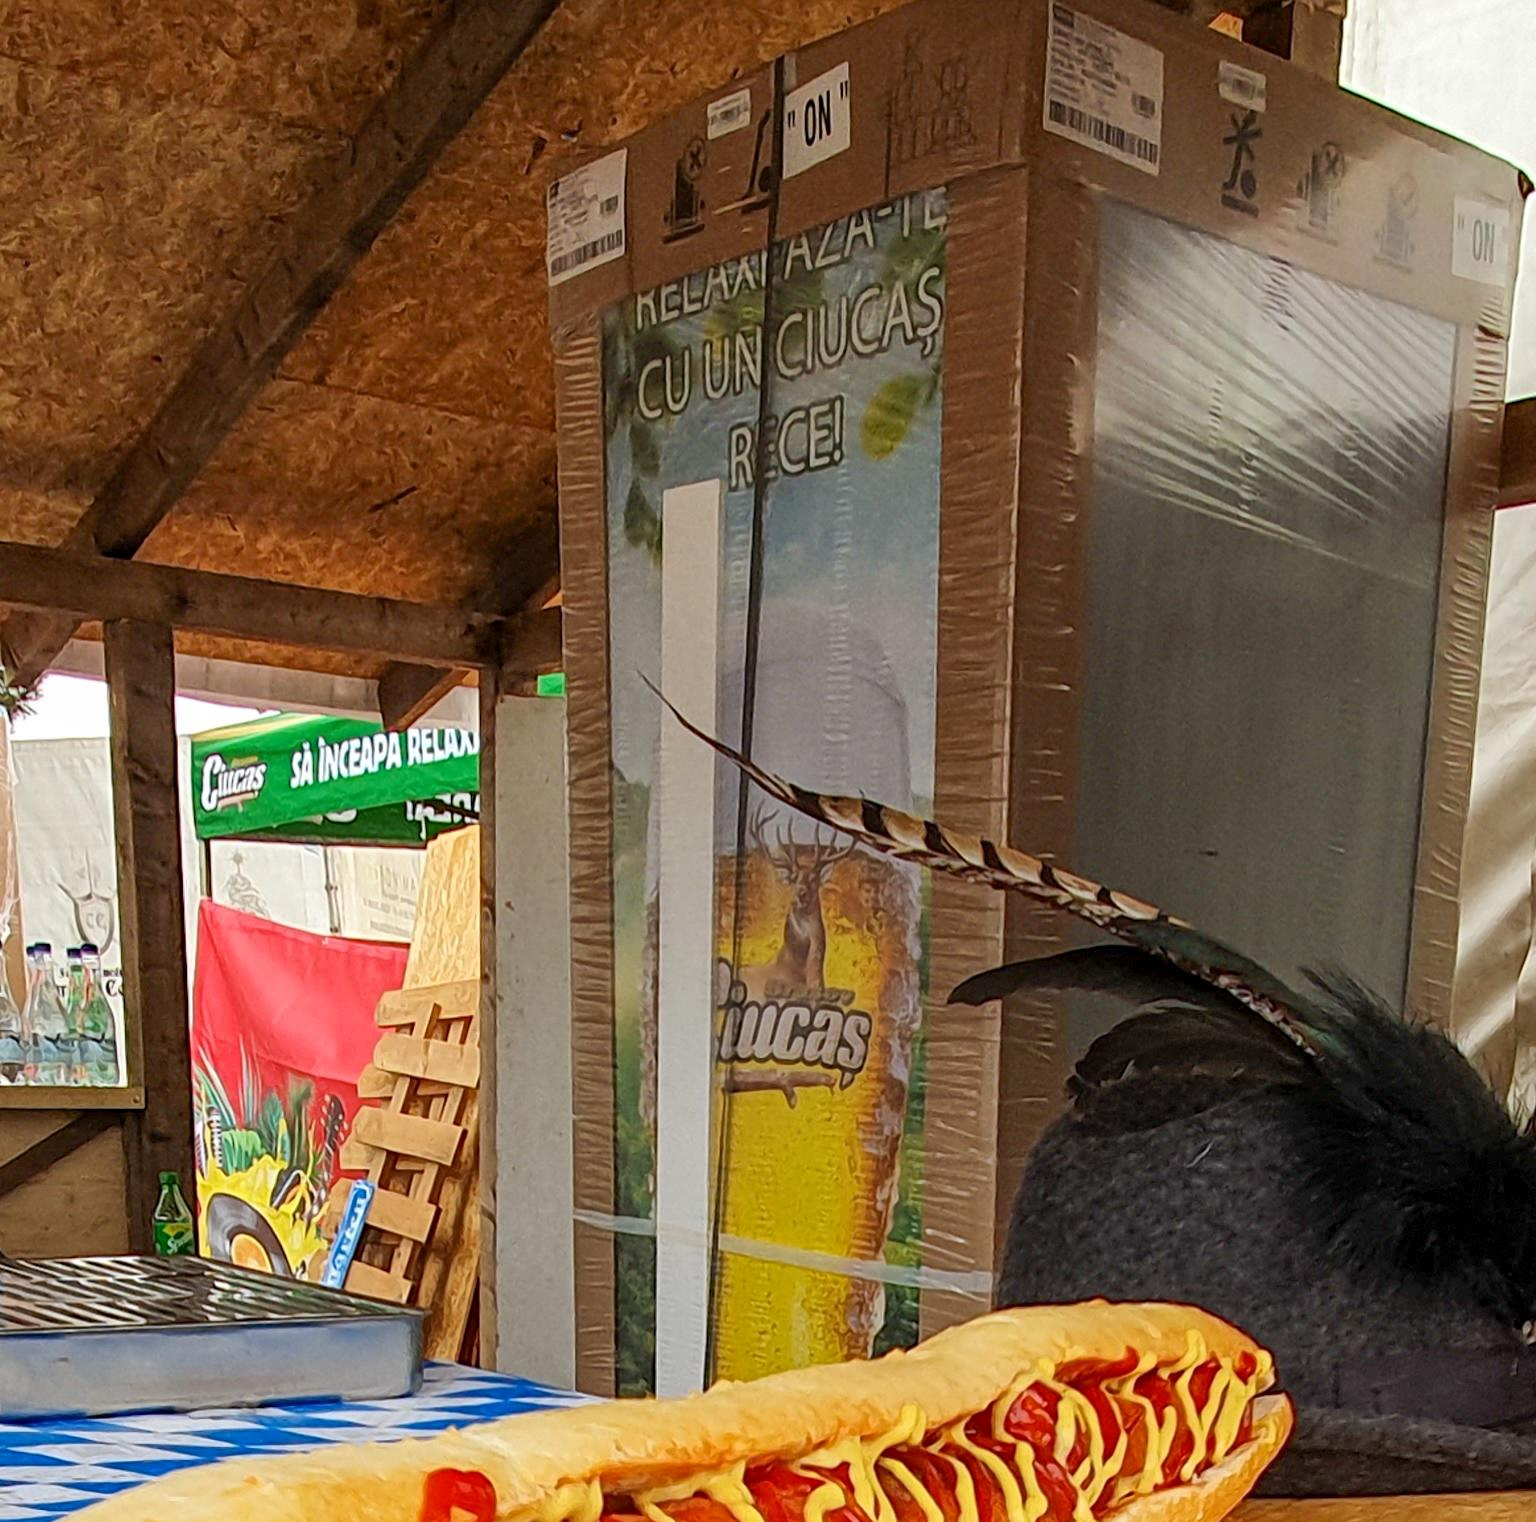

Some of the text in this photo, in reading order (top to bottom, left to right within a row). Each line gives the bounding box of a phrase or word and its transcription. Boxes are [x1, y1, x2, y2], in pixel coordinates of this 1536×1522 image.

[637, 265, 944, 420] CU UN CIUCAȘ
[406, 727, 480, 768] RELAX
